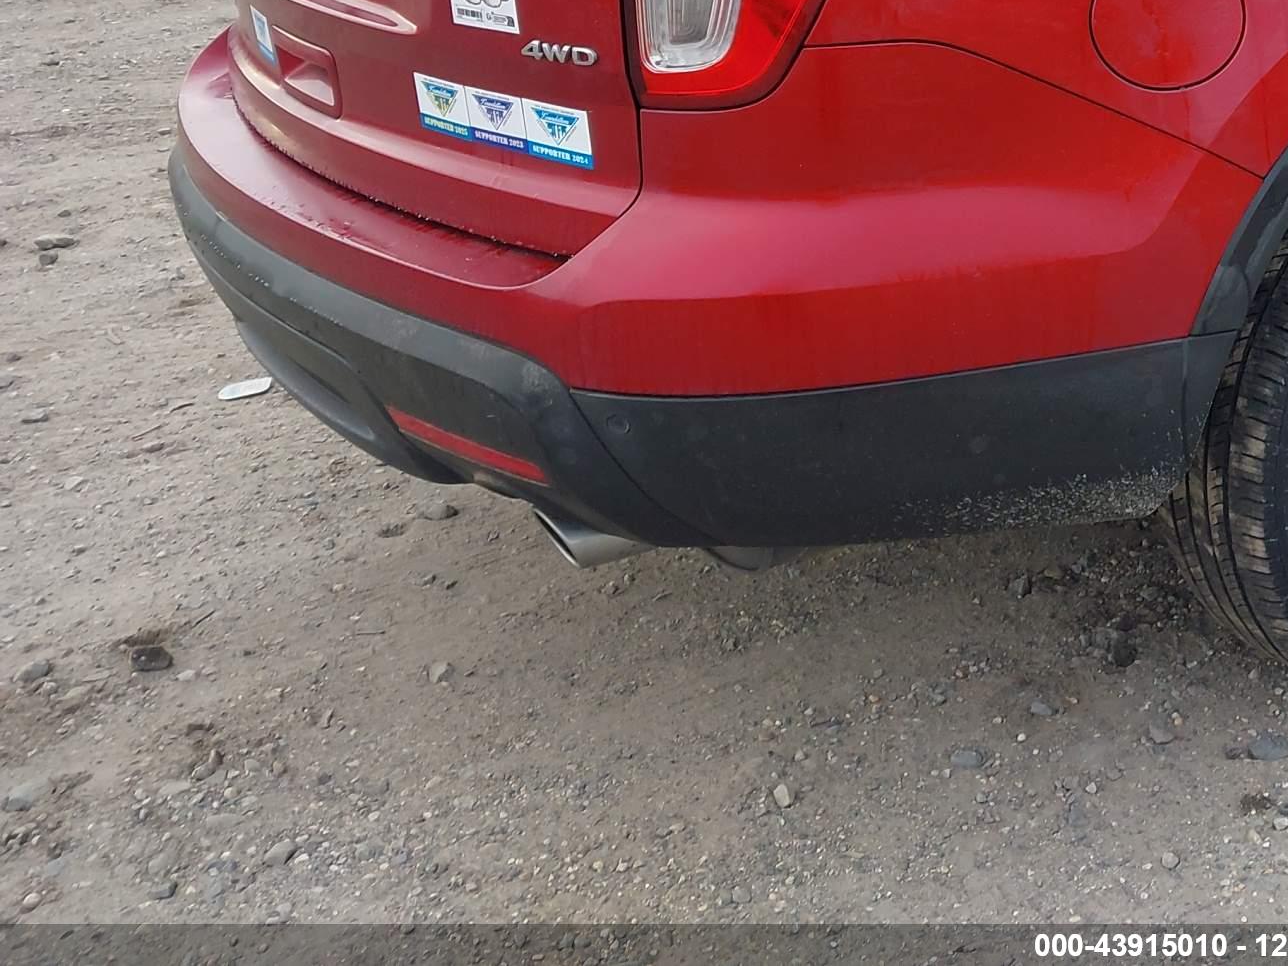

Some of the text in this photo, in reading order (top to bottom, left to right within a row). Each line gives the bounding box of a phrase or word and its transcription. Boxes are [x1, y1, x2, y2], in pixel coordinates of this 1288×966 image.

[521, 39, 598, 66] 4WD
[474, 130, 509, 146] SUPPORTER
[532, 144, 571, 160] SUPPORTER
